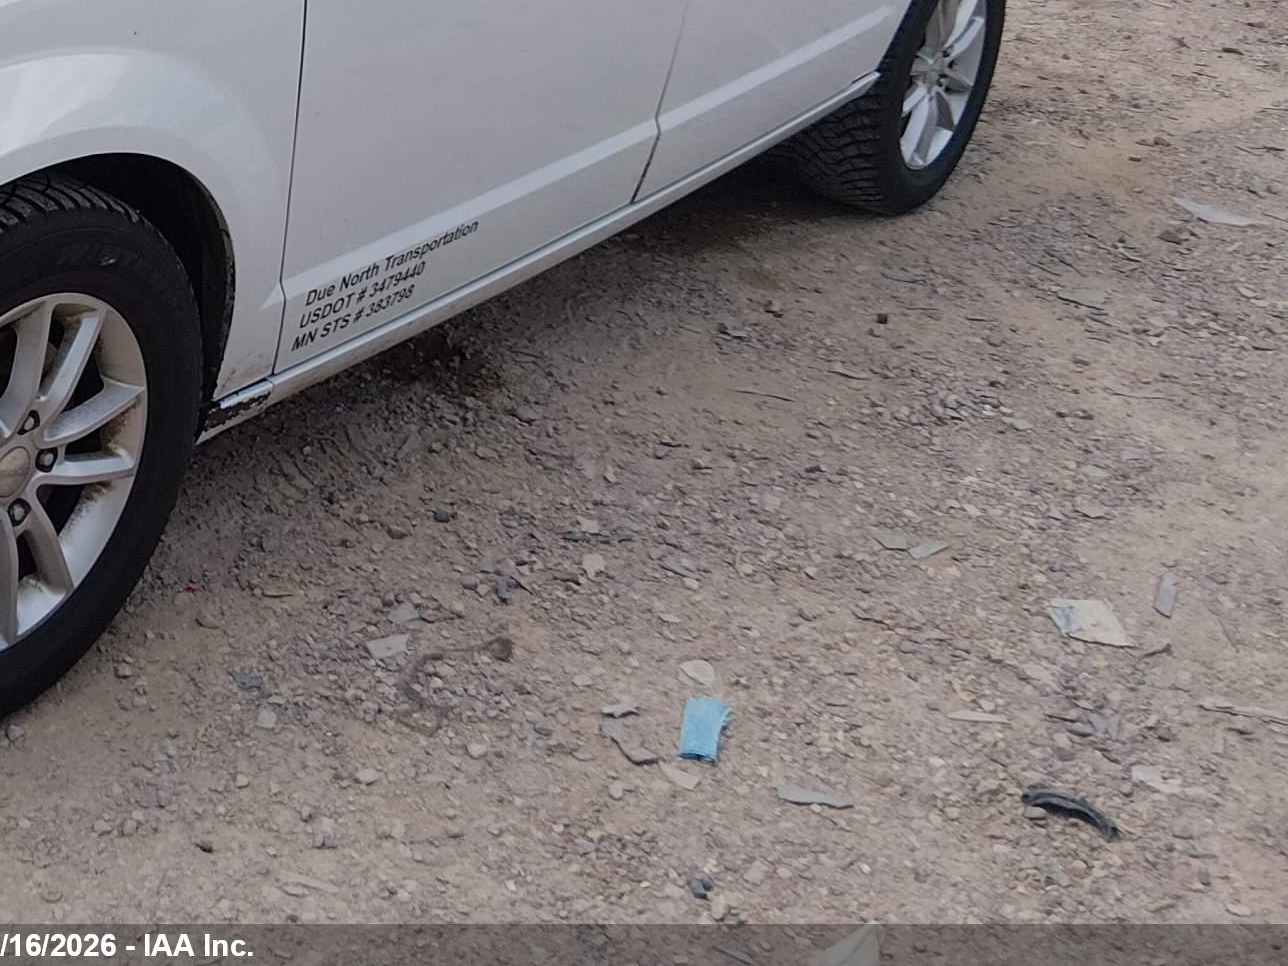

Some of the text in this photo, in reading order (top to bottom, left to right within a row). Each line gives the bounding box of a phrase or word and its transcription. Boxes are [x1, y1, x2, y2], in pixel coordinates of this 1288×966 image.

[299, 260, 426, 328] USDOT # 3479440
[305, 220, 479, 306] Due North Transportation
[291, 284, 415, 352] MN STS # 383798
